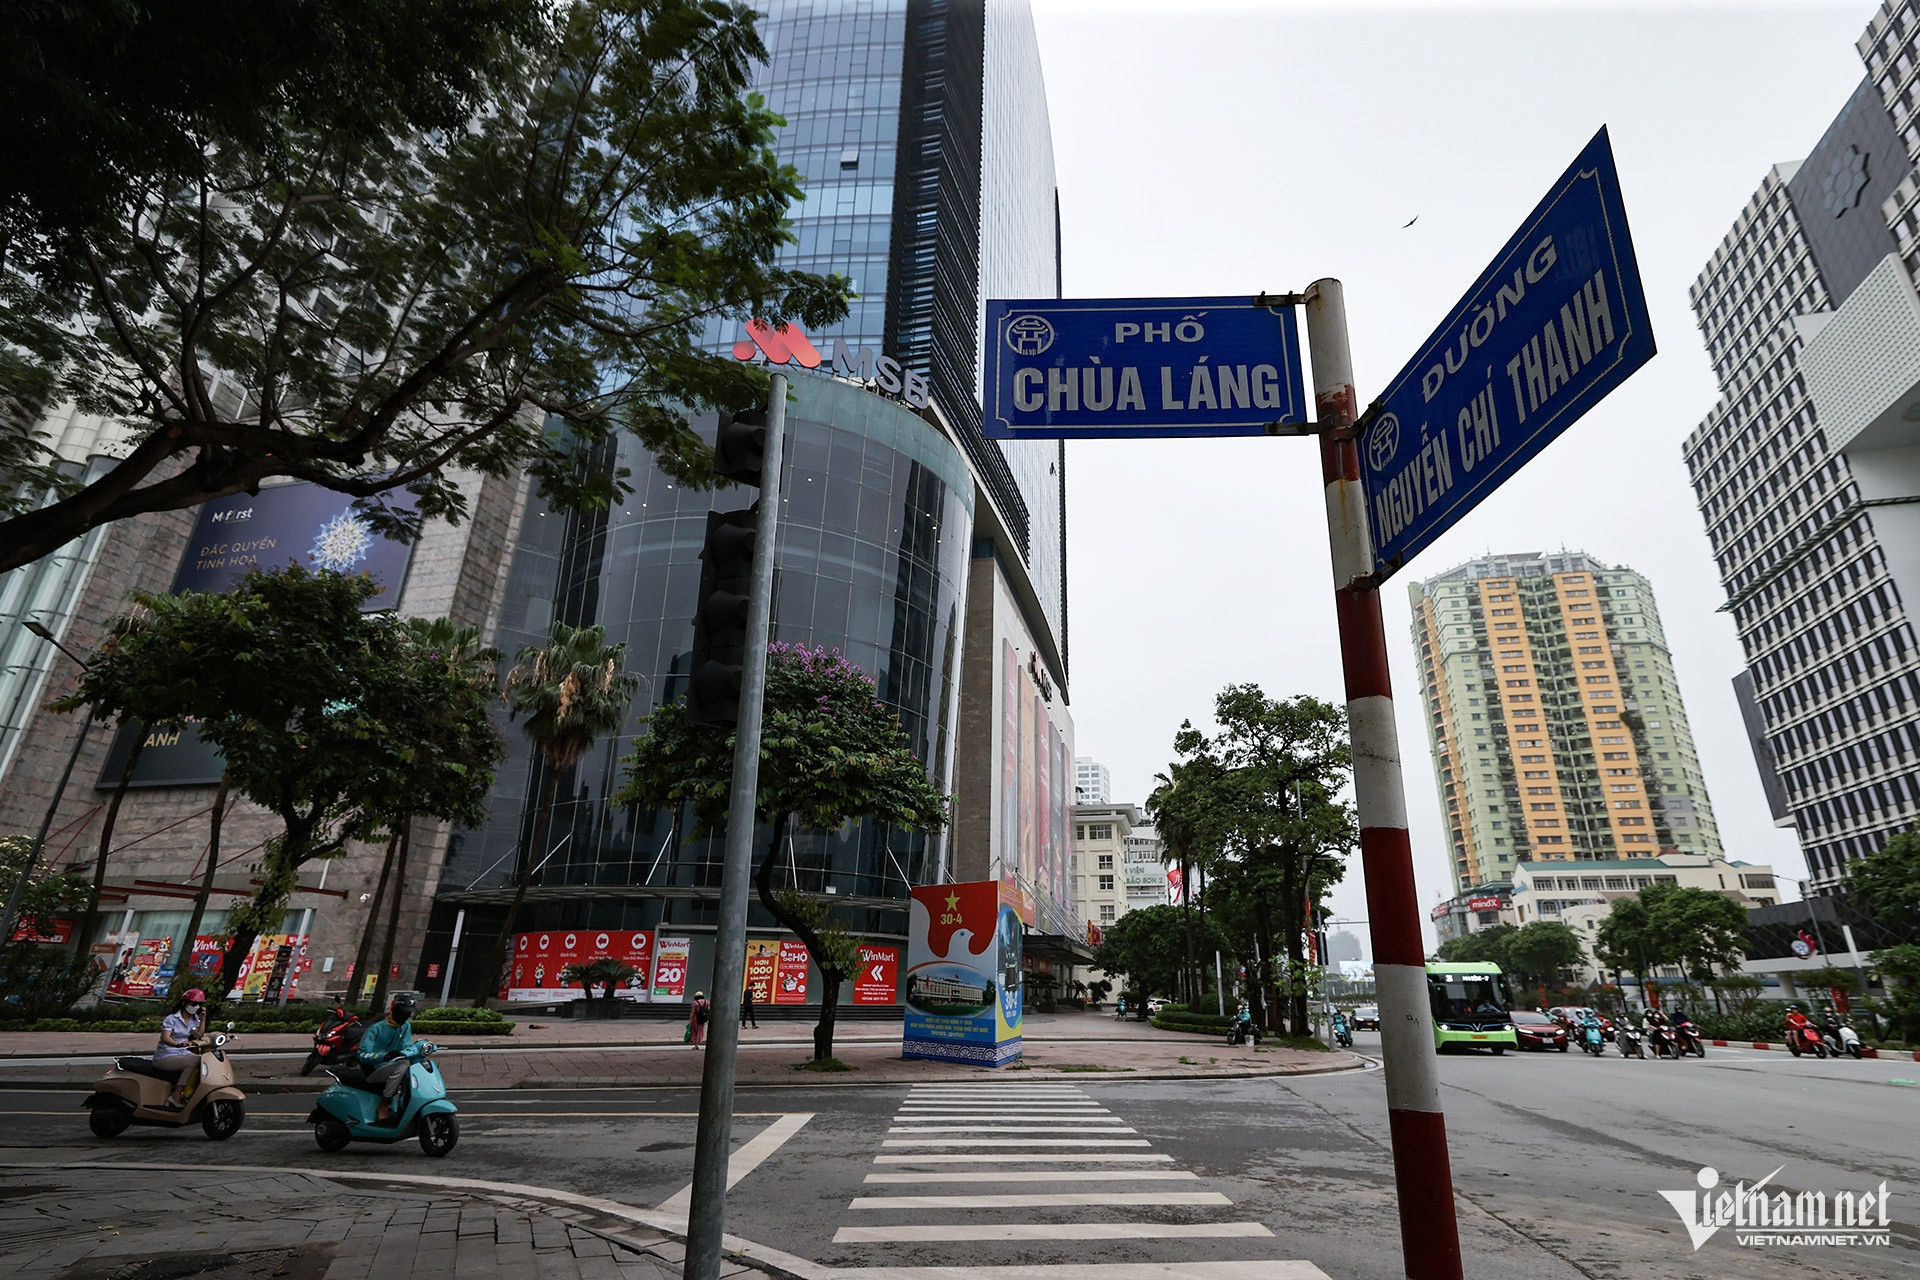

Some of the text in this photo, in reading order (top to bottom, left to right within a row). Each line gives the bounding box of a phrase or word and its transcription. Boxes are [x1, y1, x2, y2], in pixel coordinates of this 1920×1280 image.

[1115, 311, 1208, 343] PHỐ
[1421, 235, 1558, 404] ĐƯỜNG
[831, 337, 930, 410] MSB
[1013, 355, 1281, 412] CHÙA LÁNG
[1374, 268, 1616, 549] NGUYỄN CHÍ THANH
[200, 535, 277, 558] ĐẶC QUYỀN
[196, 554, 257, 571] TINH HOA
[143, 731, 181, 748] ANH
[1129, 866, 1144, 875] VIỆN
[1472, 899, 1497, 909] mindX
[660, 940, 690, 948] WinMart
[749, 966, 773, 975] 1000
